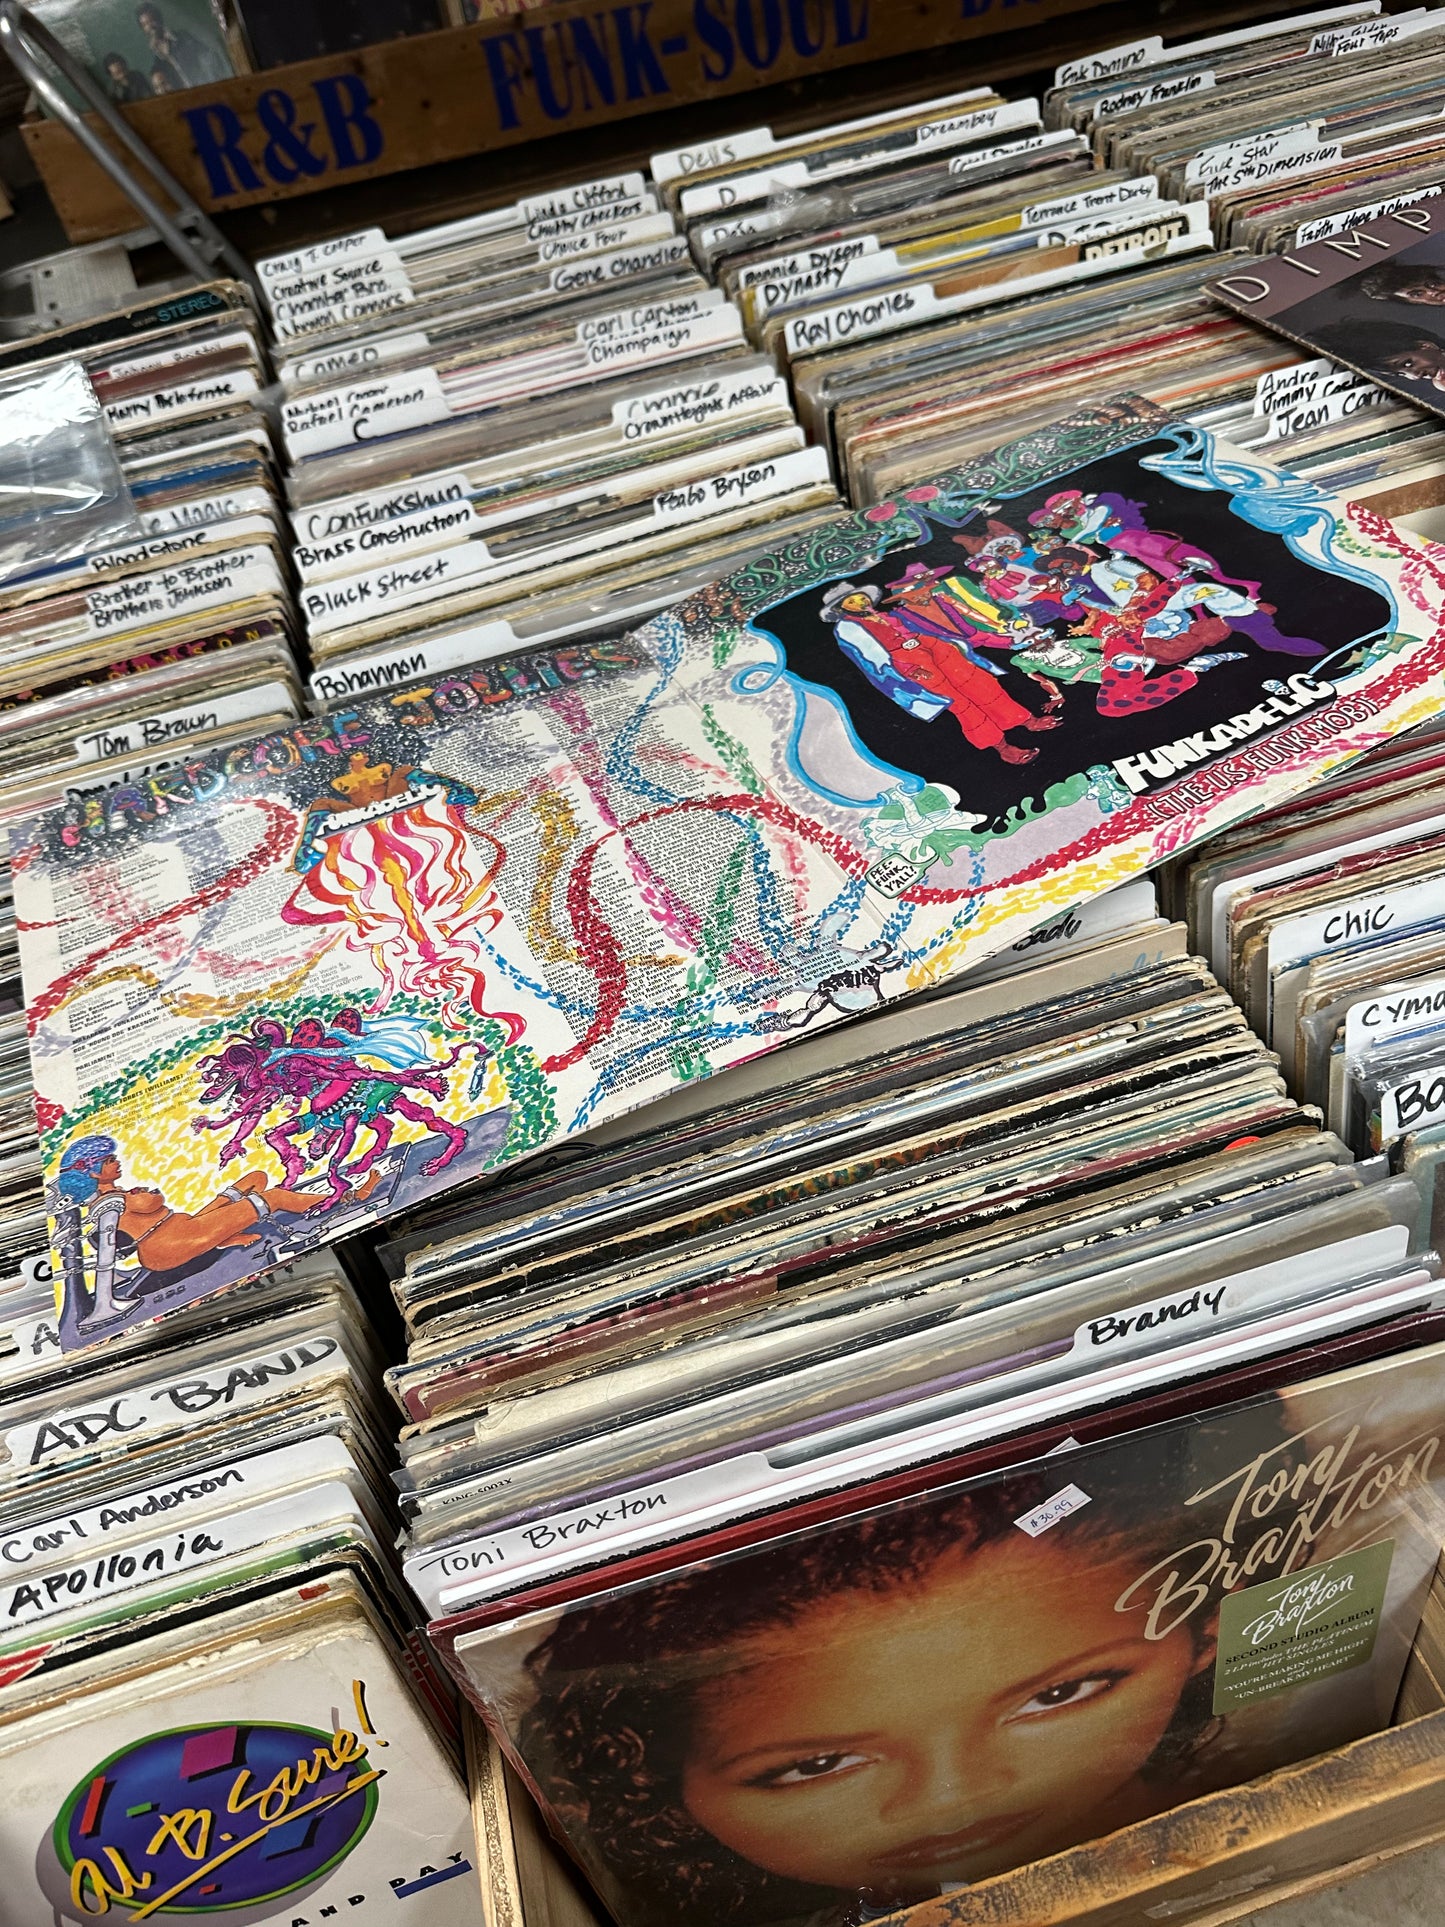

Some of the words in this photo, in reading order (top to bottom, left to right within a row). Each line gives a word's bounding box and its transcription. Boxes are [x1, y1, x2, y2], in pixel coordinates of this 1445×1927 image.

[183, 73, 386, 199] R&B
[1242, 141, 1280, 167] Star
[718, 187, 737, 208] D
[1085, 221, 1184, 262] DETROIT
[553, 263, 605, 292] Gene
[610, 243, 690, 277] Chandler
[156, 293, 222, 323] STEREO
[581, 312, 625, 341] Carl
[836, 291, 916, 336] Charles
[590, 326, 691, 364] Champaign
[1276, 404, 1330, 438] Jean
[295, 537, 355, 569] Brass
[359, 507, 471, 552] Construction
[88, 580, 153, 611] Brother
[305, 579, 371, 617] Black
[376, 557, 450, 599] Street
[313, 652, 428, 701] Bohannon
[83, 731, 132, 757] Tom
[138, 712, 218, 746] Brown
[1248, 730, 1318, 772] FUNK
[314, 782, 443, 839] FUNKADELIC
[884, 865, 918, 892] Y'ALL!
[1087, 1285, 1227, 1346] Brandy
[29, 1398, 148, 1467] ADC
[150, 1338, 339, 1415] BAND
[2, 1519, 88, 1565] Carl
[99, 1468, 245, 1532] Anderson
[418, 1540, 505, 1577] Toni
[521, 1493, 668, 1550] Braxton
[1114, 1436, 1440, 1641] Braxton
[1241, 1574, 1356, 1646] Braxton
[1225, 1641, 1279, 1665] SECOND
[1280, 1624, 1330, 1647] STUDIO
[1331, 1606, 1376, 1628] ALBUM
[1267, 1658, 1317, 1678] MAKING
[1316, 1650, 1335, 1662] ME
[144, 1807, 236, 1862] B.
[225, 1679, 391, 1822] Sure!
[387, 1850, 464, 1891] DAY
